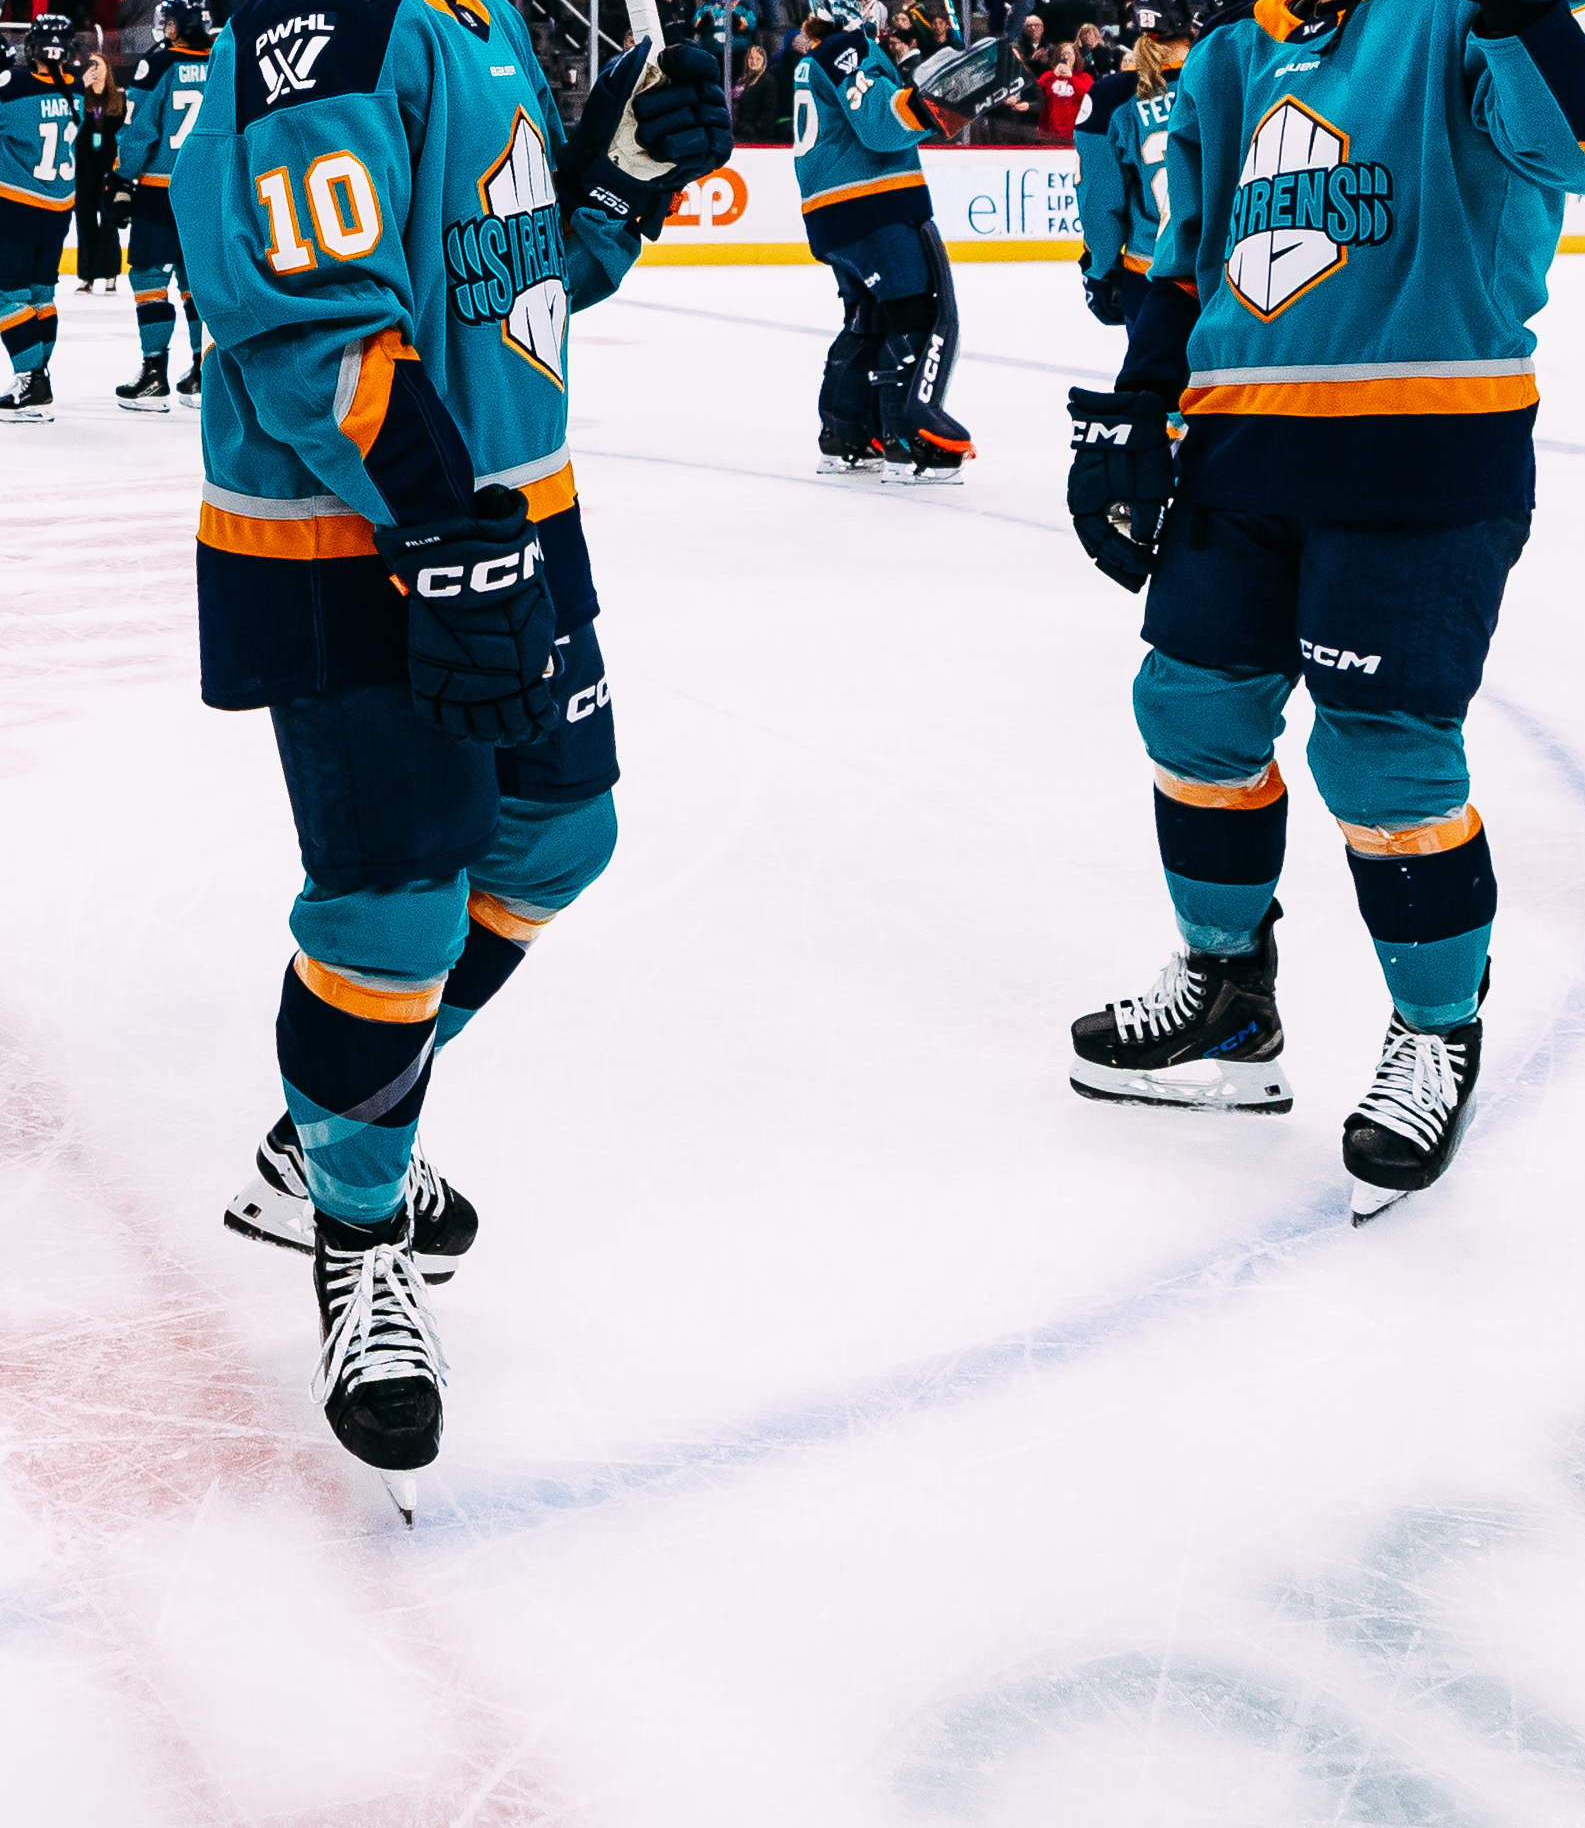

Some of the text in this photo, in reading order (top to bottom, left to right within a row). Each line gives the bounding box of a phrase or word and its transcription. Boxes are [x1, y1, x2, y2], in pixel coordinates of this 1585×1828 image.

[255, 12, 335, 60] PWHL
[255, 150, 384, 276] 10
[918, 334, 945, 404] CCM
[405, 535, 441, 548] FILLIER
[1202, 1020, 1258, 1060] CCM
